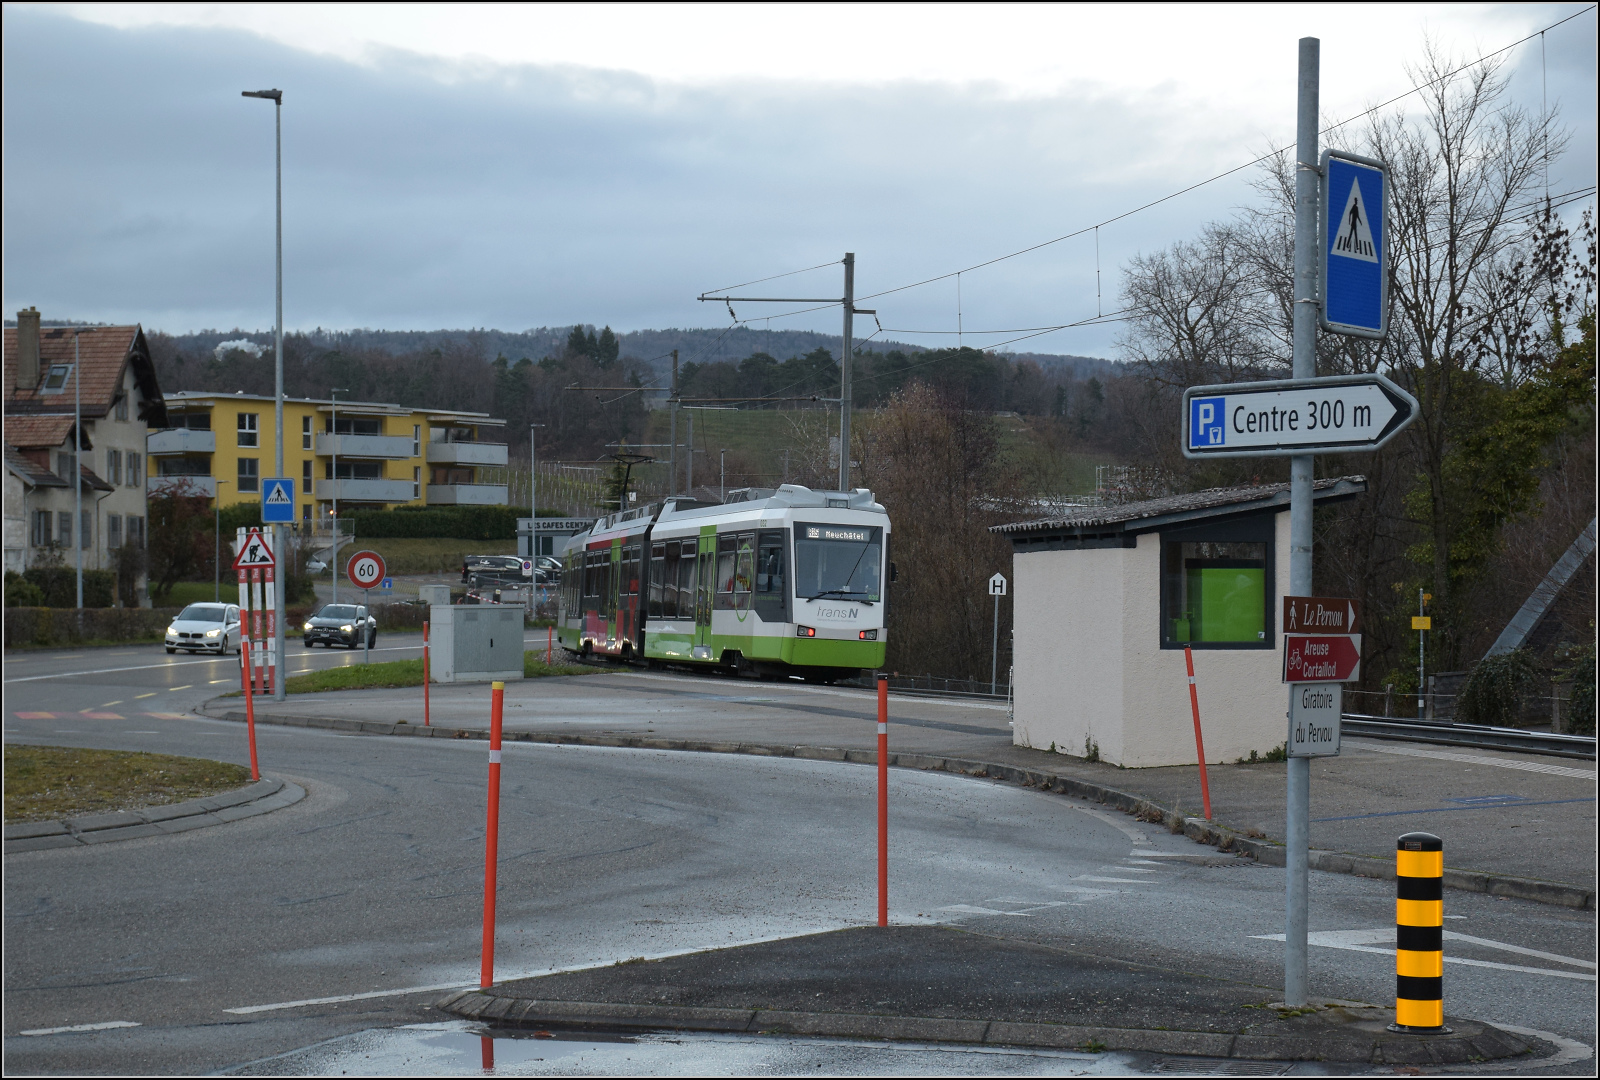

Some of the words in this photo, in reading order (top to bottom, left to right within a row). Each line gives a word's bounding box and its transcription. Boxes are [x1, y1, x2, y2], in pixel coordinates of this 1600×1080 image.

[1233, 405, 1299, 434] Centre
[1307, 399, 1345, 430] 300
[1353, 404, 1371, 427] m
[825, 530, 864, 540] Neuchâtel
[359, 563, 374, 577] 60
[993, 579, 1003, 594] H
[817, 606, 859, 619] transN
[1303, 603, 1315, 626] Le
[1315, 603, 1343, 627] Pervou
[1304, 639, 1329, 656] Areuse
[1302, 661, 1337, 678] Cortaillod
[1302, 686, 1333, 709] Giratoire
[1295, 721, 1305, 744] du
[1308, 722, 1333, 743] Pervou
